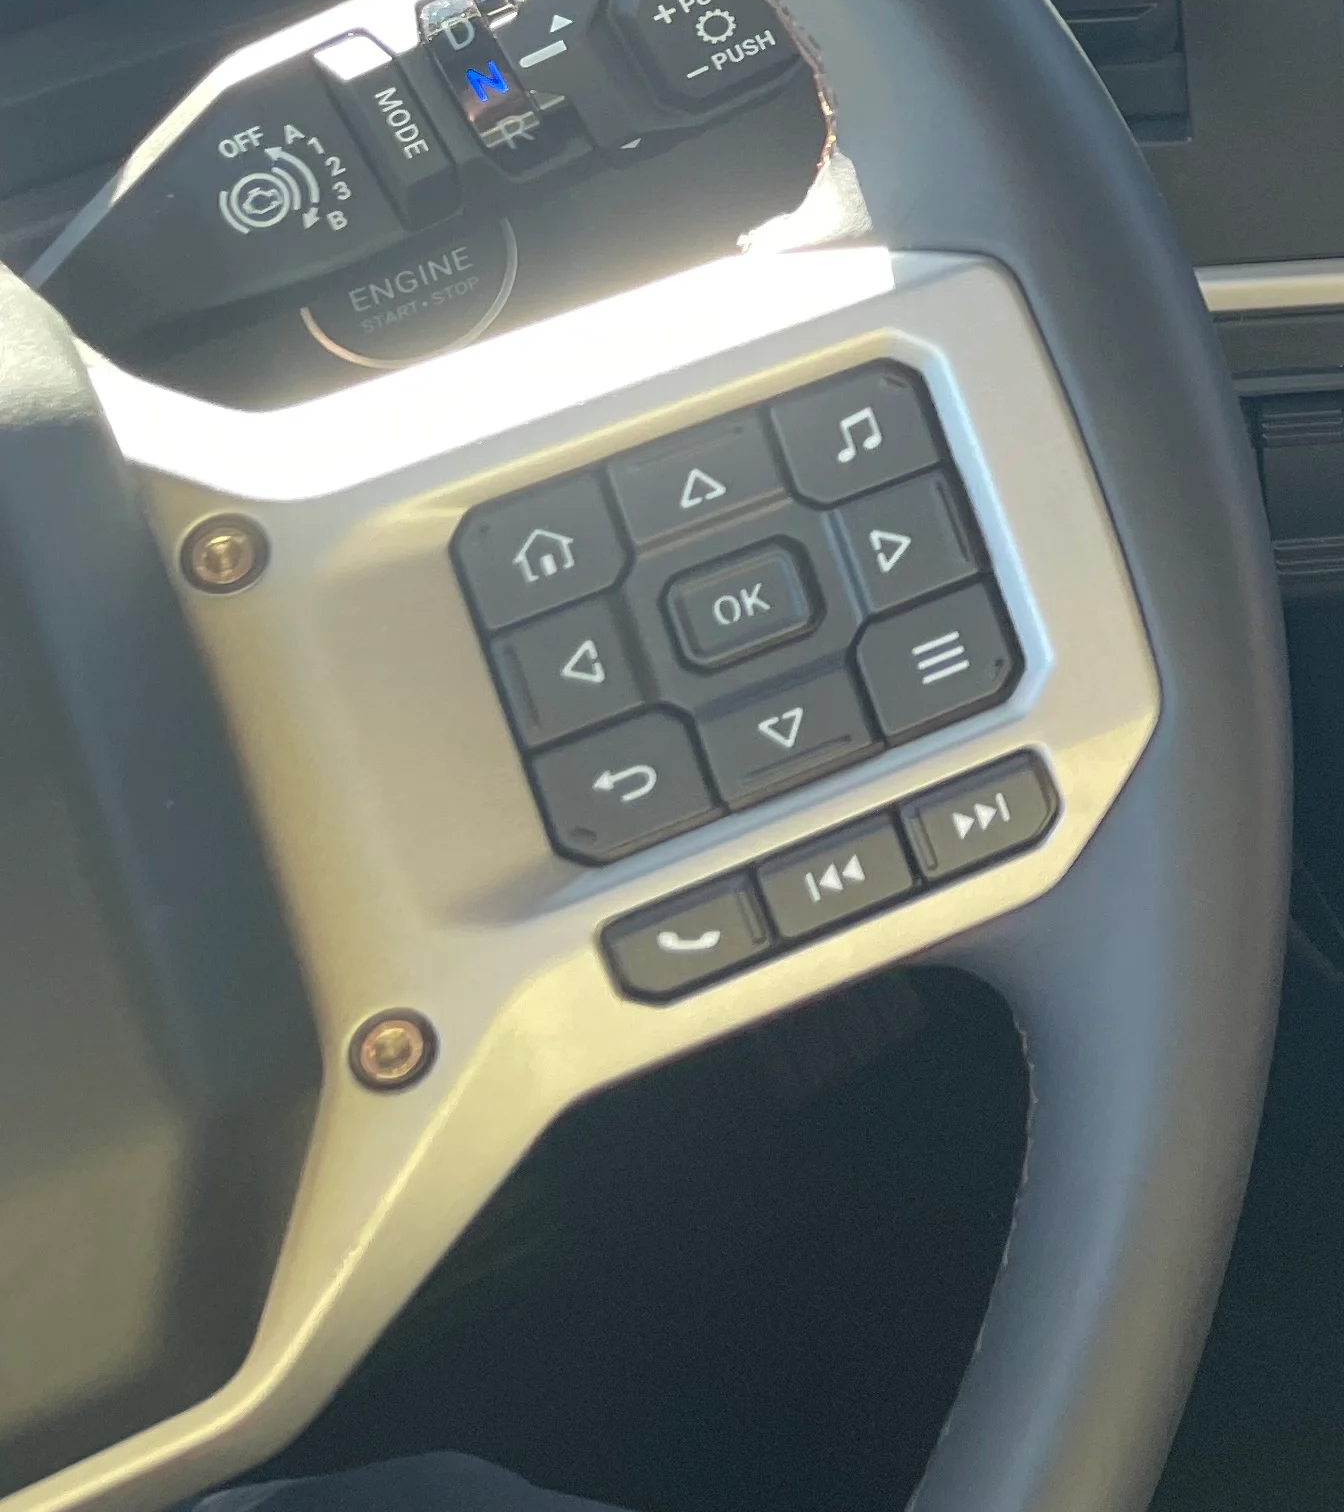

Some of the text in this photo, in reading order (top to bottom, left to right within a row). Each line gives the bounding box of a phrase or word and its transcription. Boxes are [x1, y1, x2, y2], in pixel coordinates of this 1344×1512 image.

[442, 16, 475, 51] D
[710, 29, 776, 71] PUSH
[465, 59, 509, 102] N
[283, 124, 305, 145] A
[374, 86, 430, 160] MODE
[500, 114, 535, 149] R
[217, 125, 265, 159] OFF
[306, 137, 325, 155] 1
[324, 156, 347, 177] 2
[332, 181, 352, 200] 3
[326, 209, 348, 232] B
[347, 246, 474, 313] ENGINE
[713, 582, 772, 625] OK
